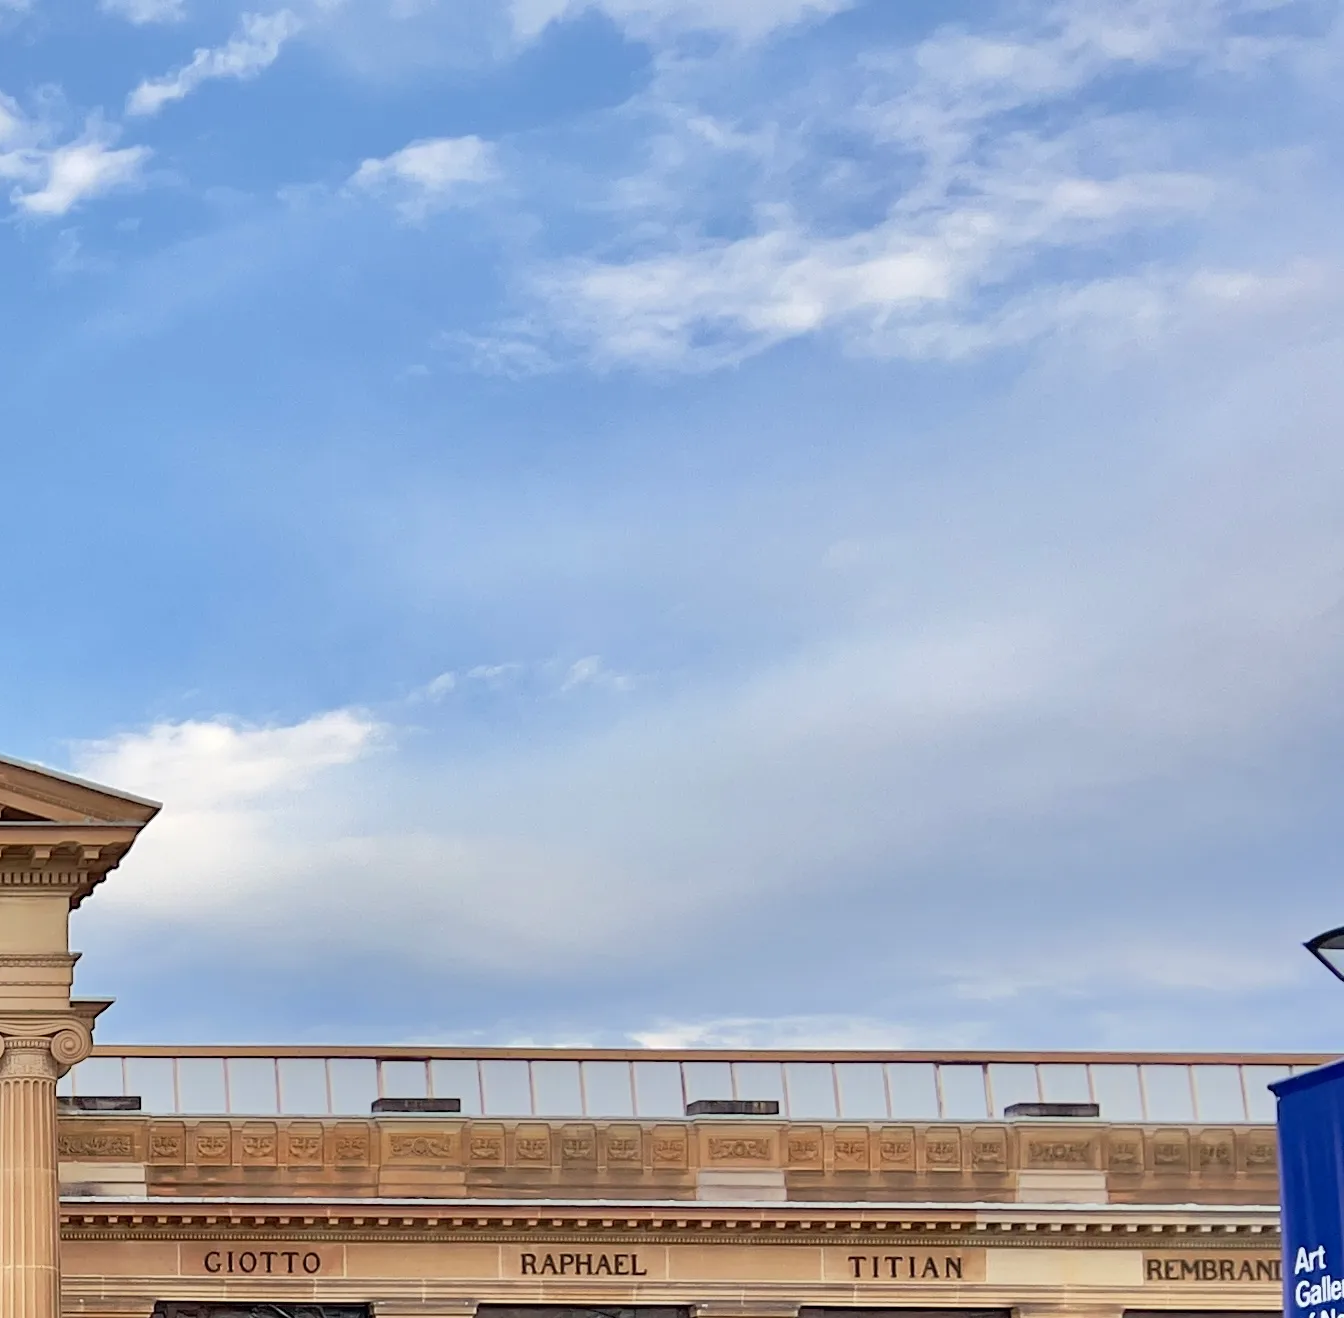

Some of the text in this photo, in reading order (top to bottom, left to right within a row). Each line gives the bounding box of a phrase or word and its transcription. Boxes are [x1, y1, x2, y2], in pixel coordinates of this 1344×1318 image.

[204, 1250, 321, 1274] GIOTTO
[520, 1253, 648, 1276] RAPHAEL
[847, 1255, 963, 1279] TITIAN
[1294, 1245, 1327, 1275] Art
[1295, 1275, 1344, 1308] Galle
